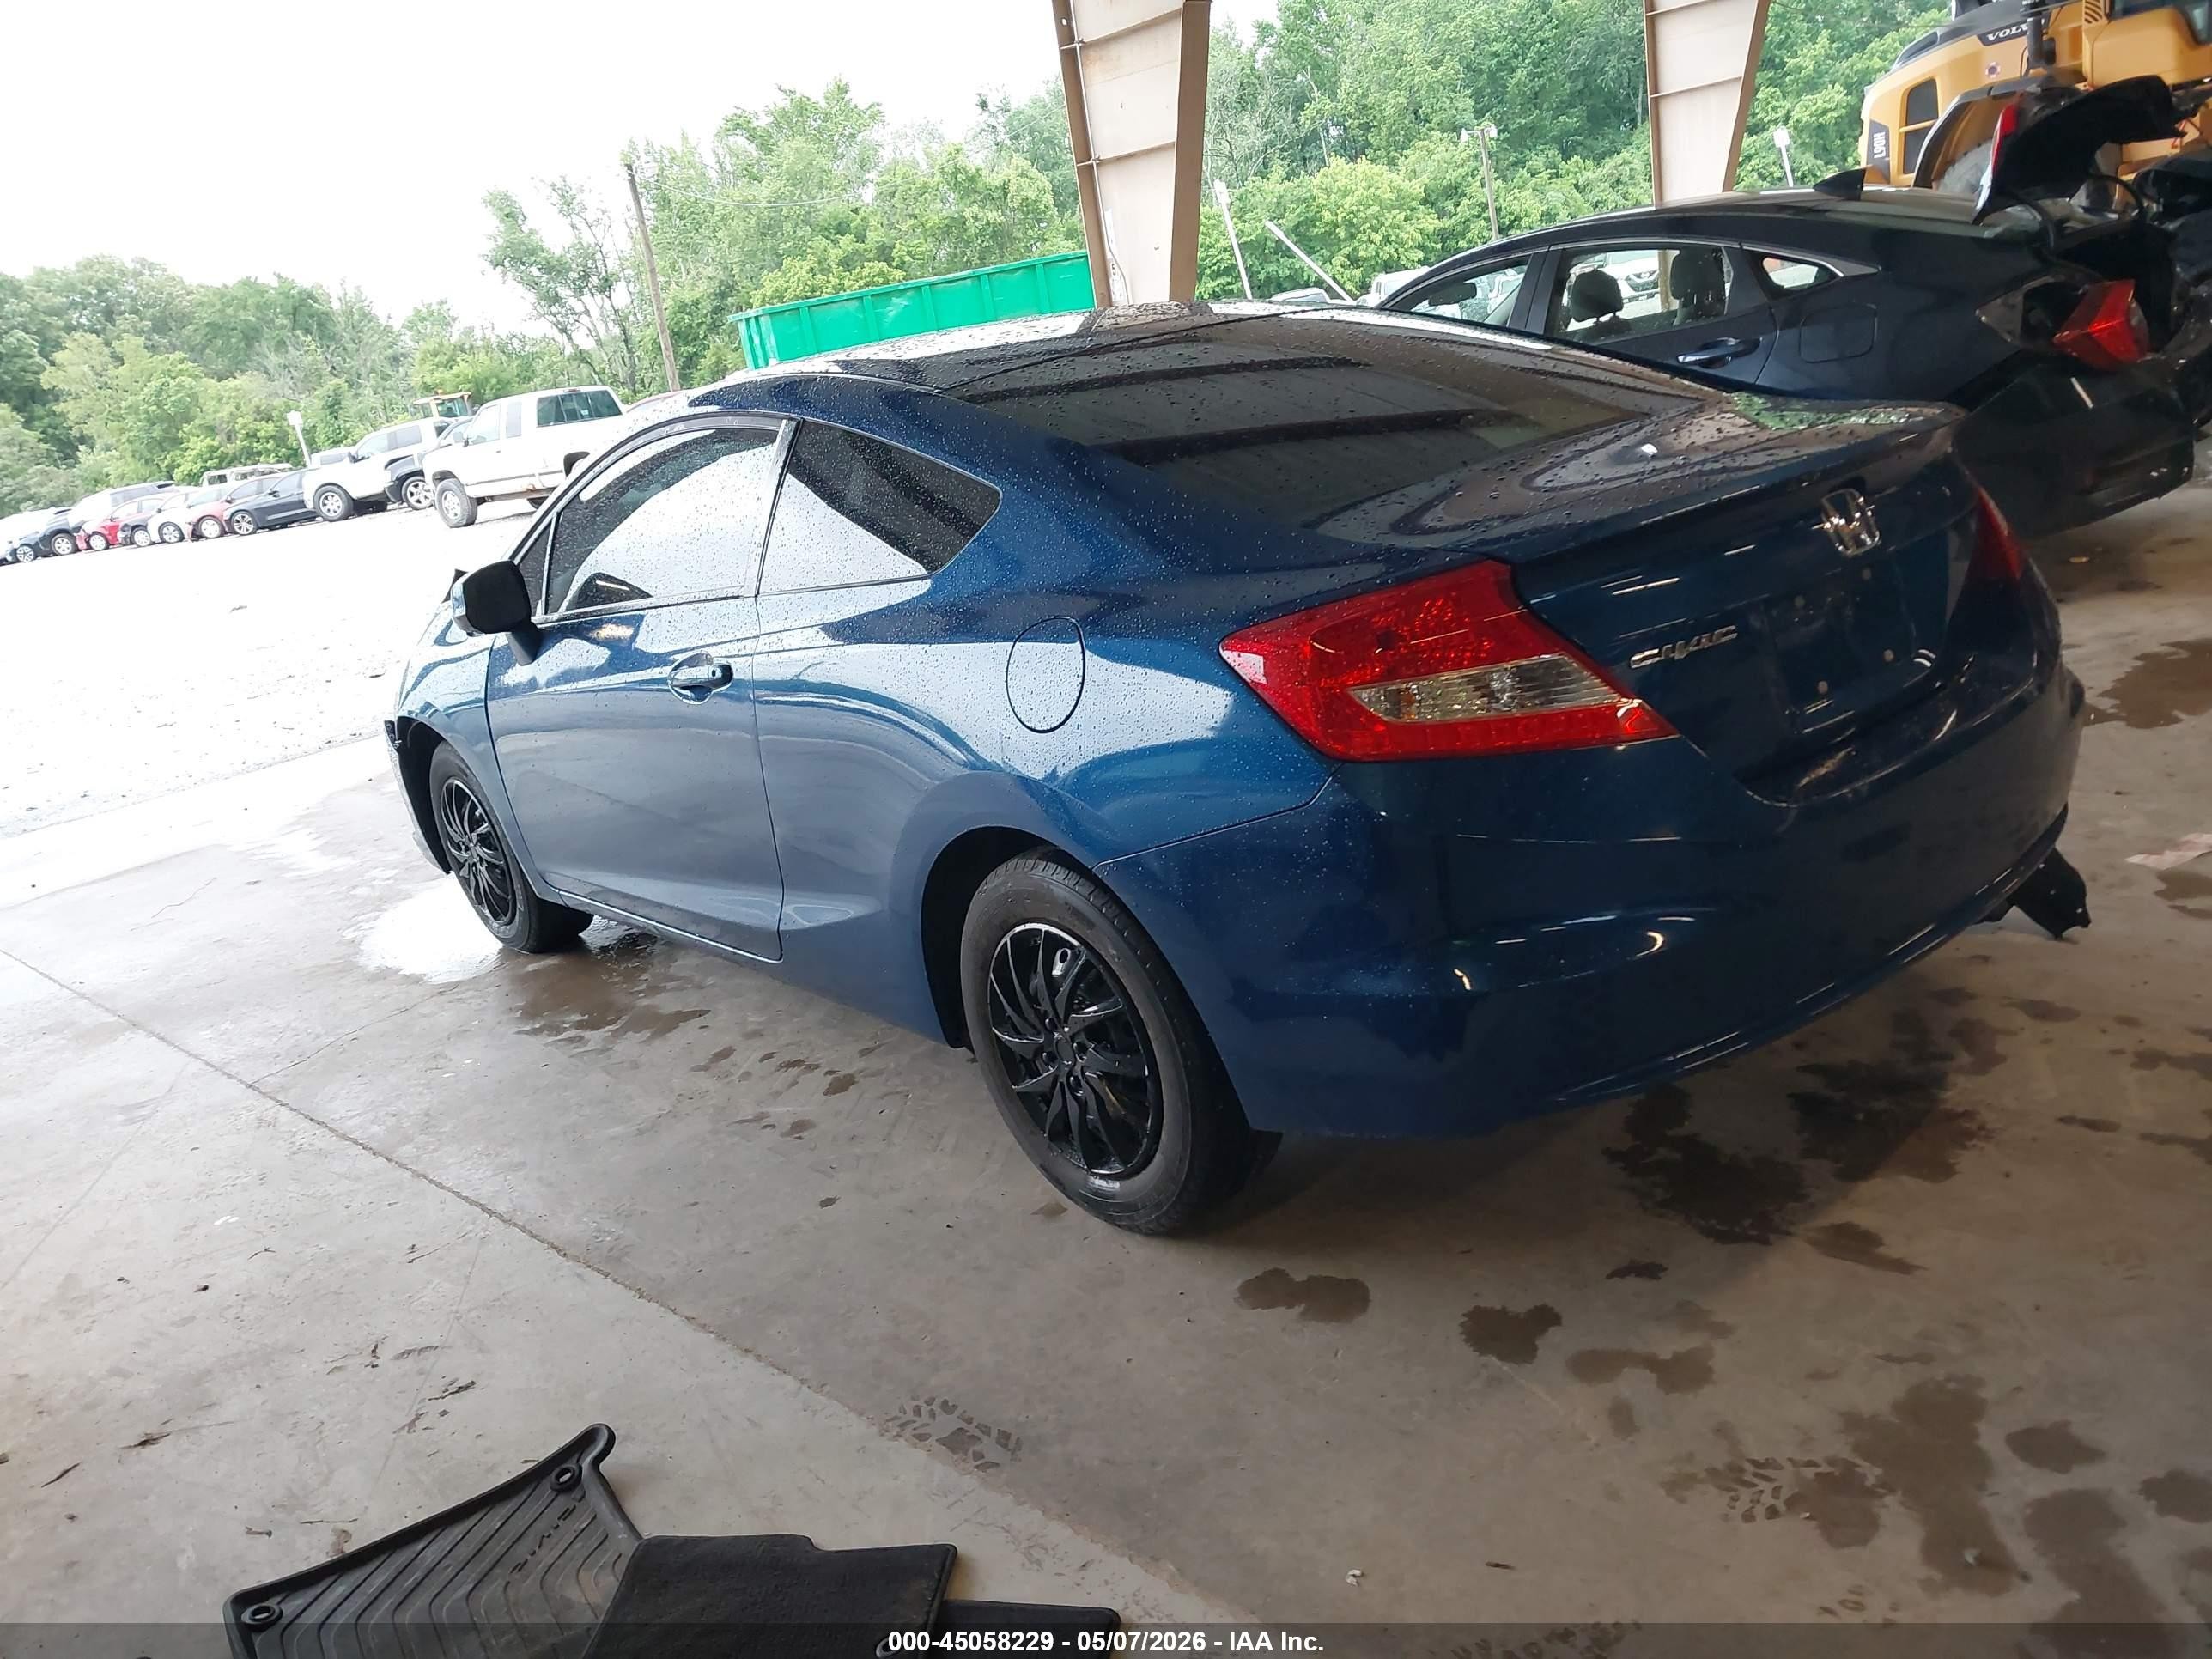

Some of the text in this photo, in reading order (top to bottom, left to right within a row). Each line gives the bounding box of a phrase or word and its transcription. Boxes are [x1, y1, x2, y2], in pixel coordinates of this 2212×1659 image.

[1986, 18, 2045, 40] VOLV
[1873, 131, 1886, 159] L90H
[1630, 624, 1738, 669] CIVIC
